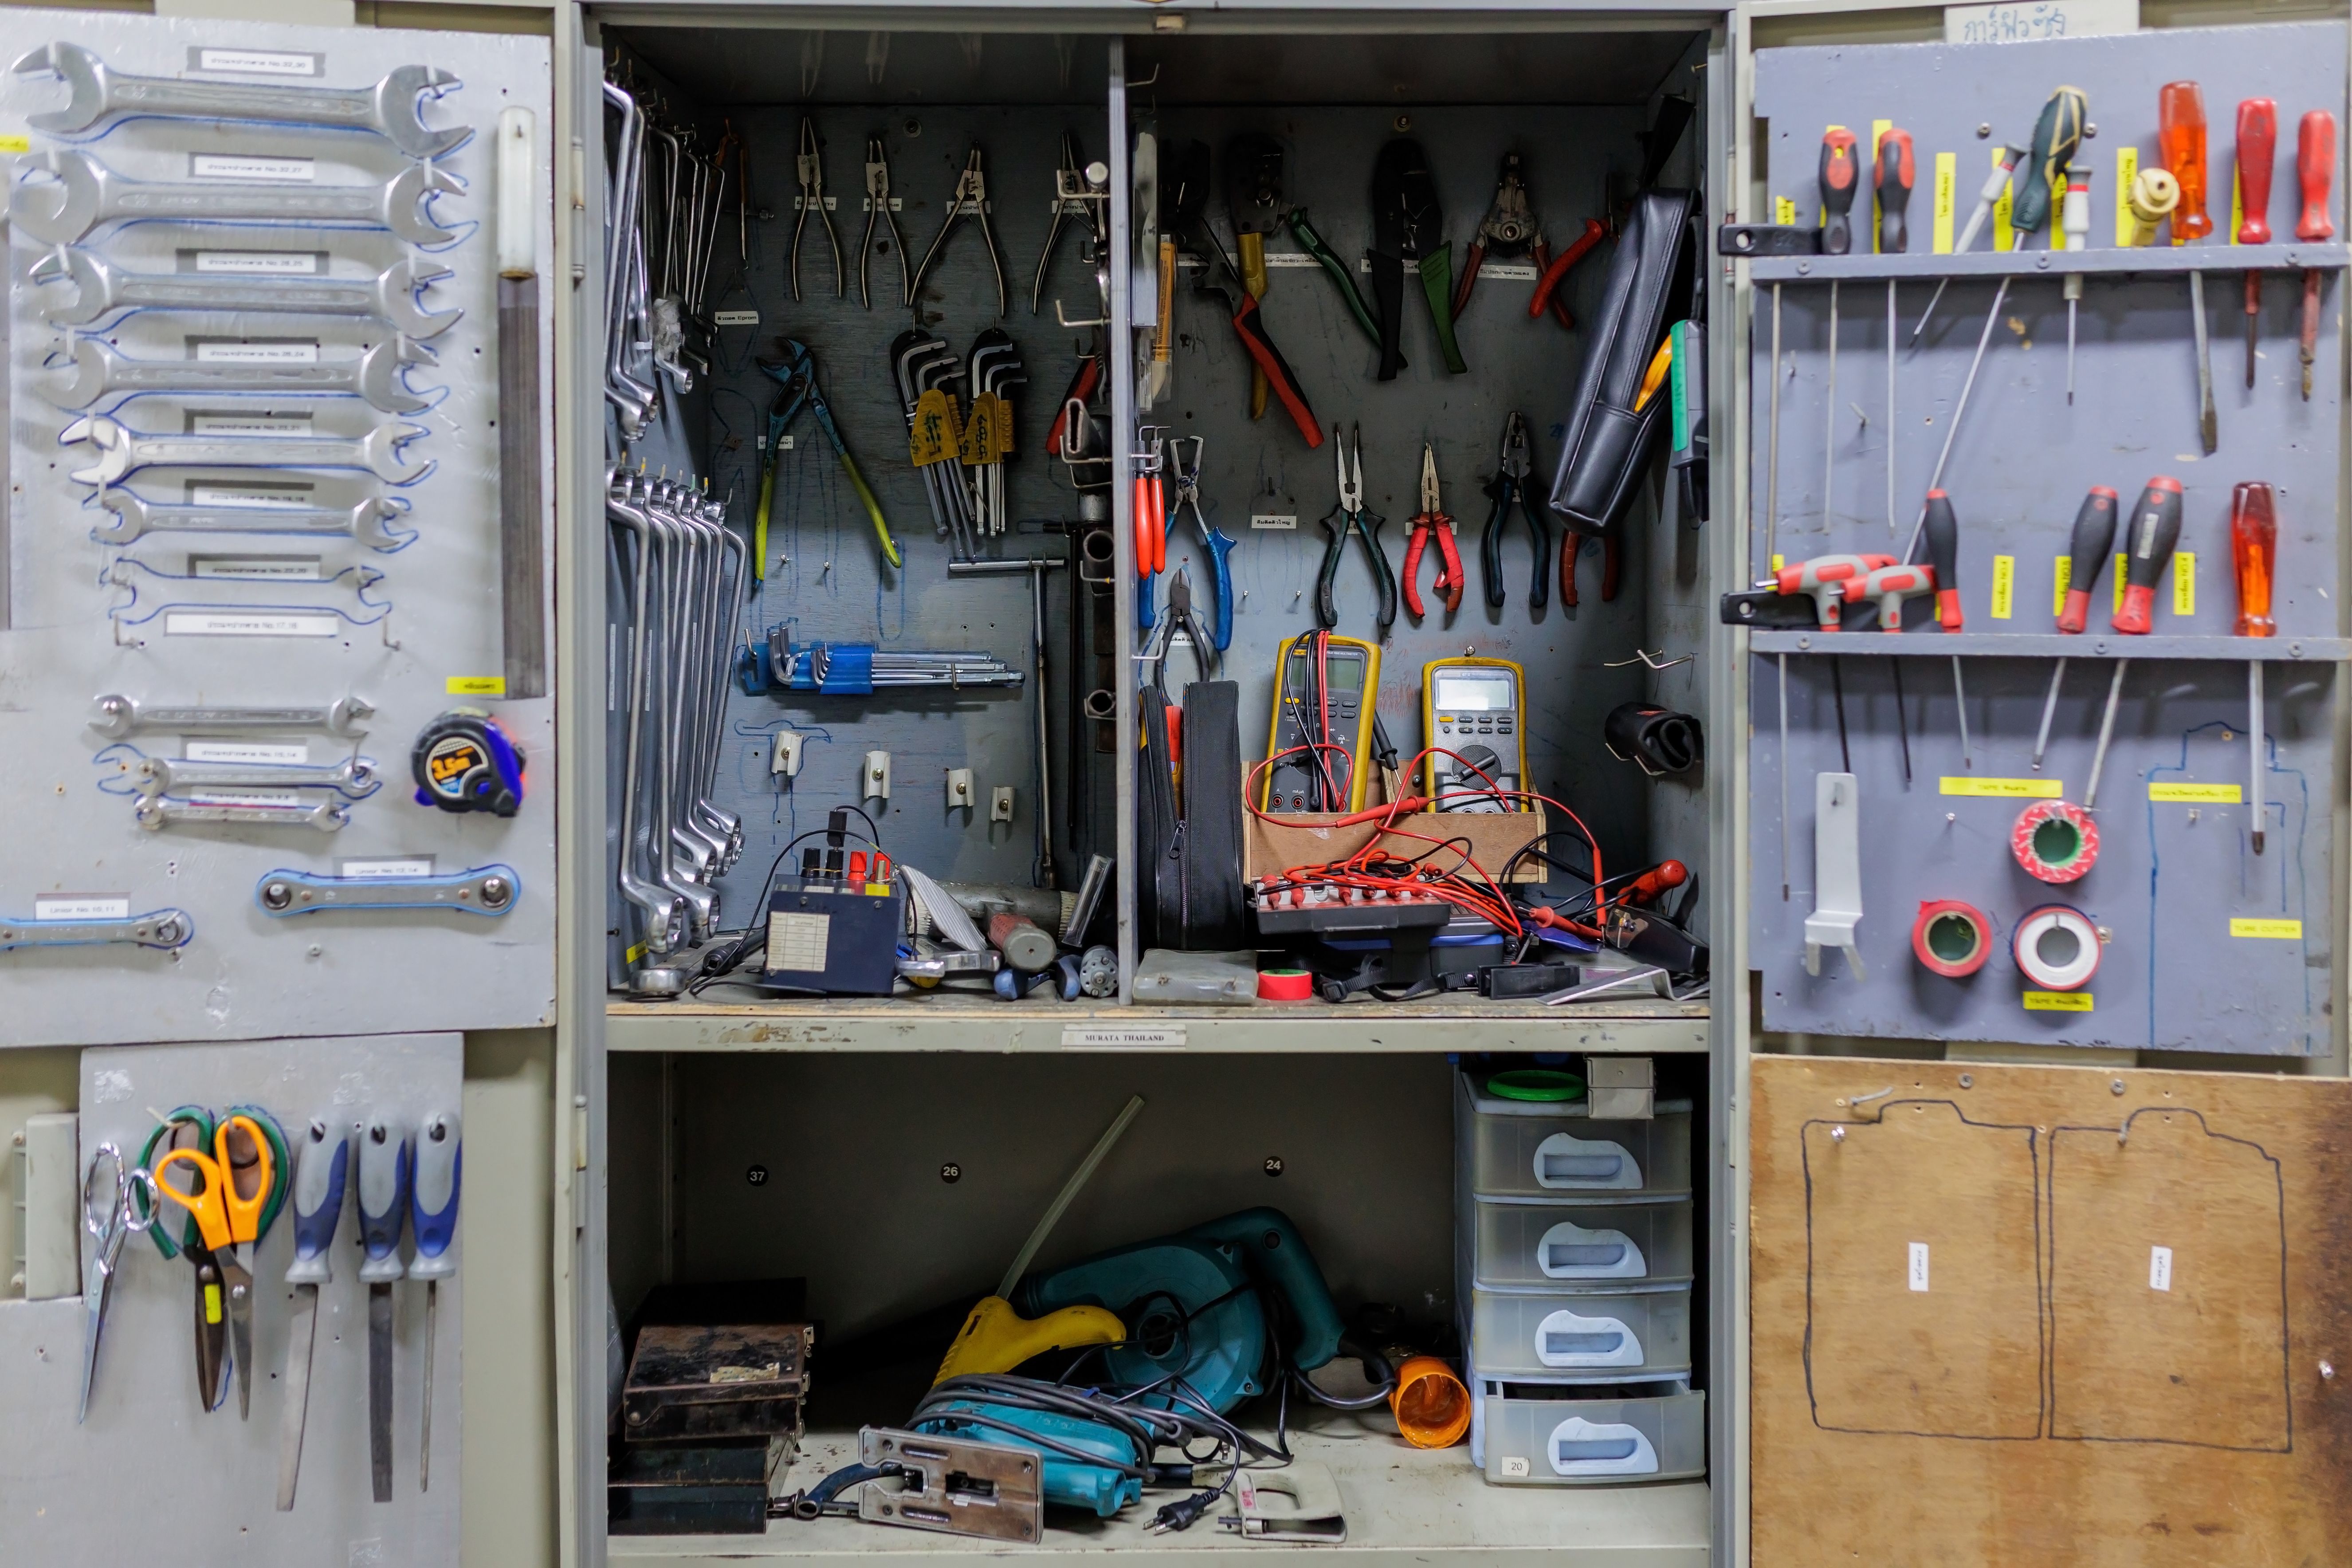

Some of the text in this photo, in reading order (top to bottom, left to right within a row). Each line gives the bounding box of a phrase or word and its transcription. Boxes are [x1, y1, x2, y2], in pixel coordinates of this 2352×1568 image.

[1266, 1160, 1281, 1170] 24
[750, 1171, 765, 1181] 37
[943, 1166, 958, 1176] 26
[1511, 1462, 1522, 1471] 20
